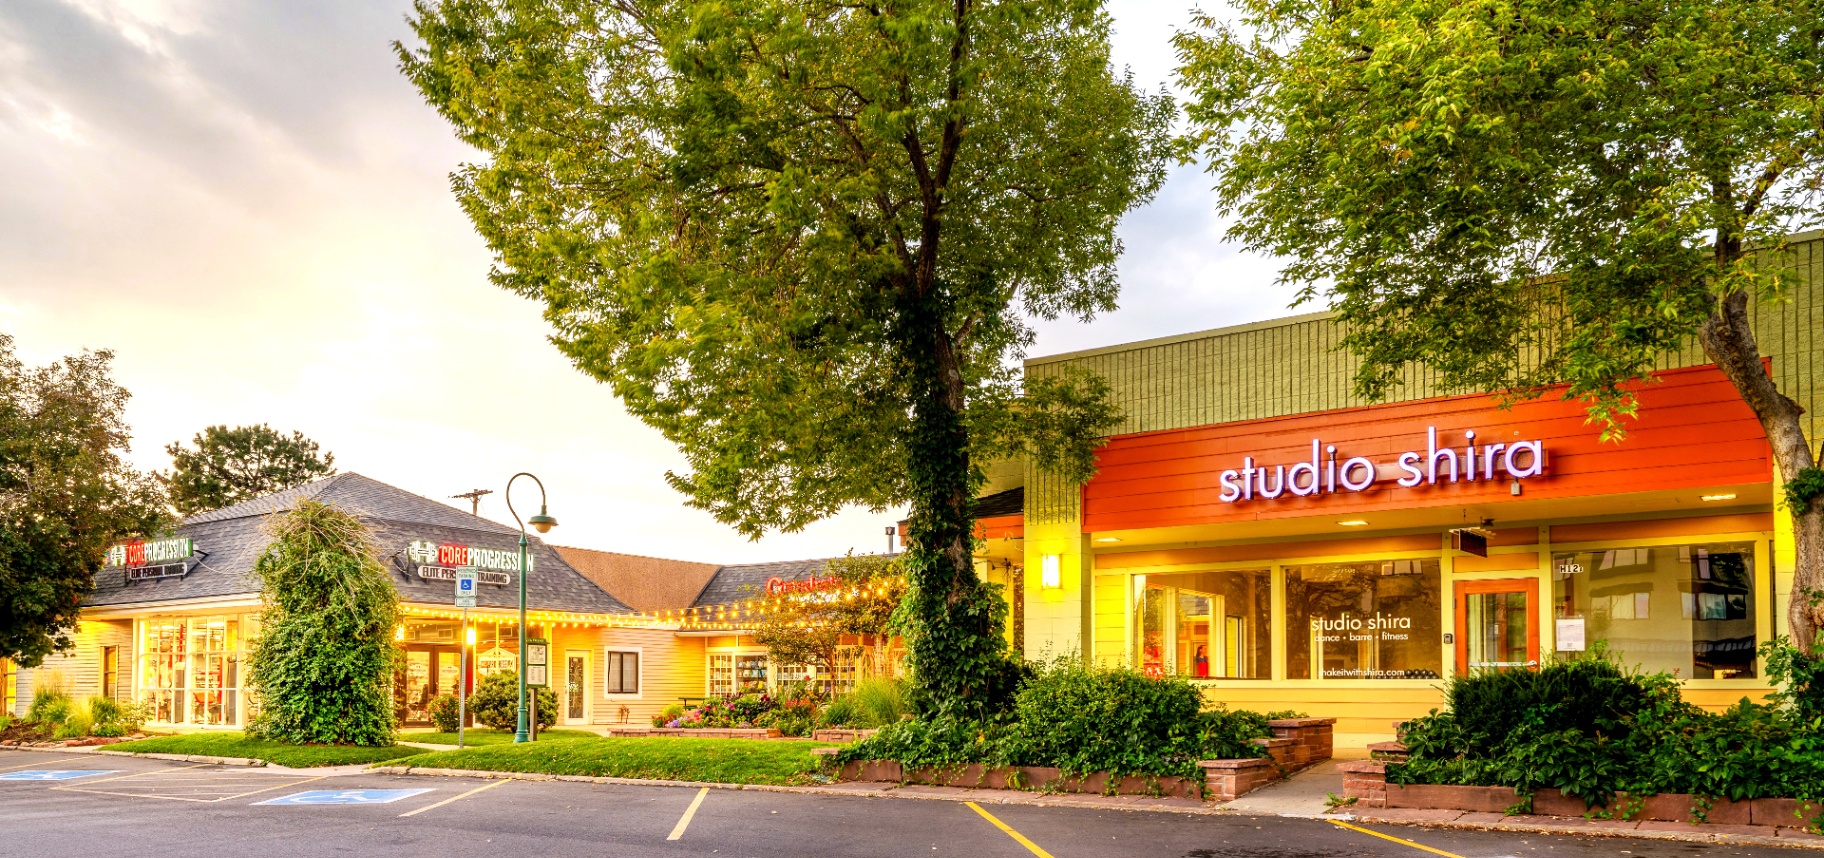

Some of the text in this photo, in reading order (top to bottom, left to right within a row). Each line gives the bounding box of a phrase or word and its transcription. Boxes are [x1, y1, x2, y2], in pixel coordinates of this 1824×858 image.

[1219, 426, 1545, 503] studio shira
[441, 545, 534, 572] COREPROGRESSIN
[422, 566, 507, 584] ELITE PERS TRAINING
[1311, 611, 1411, 631] studio shira
[1315, 631, 1409, 642] dance barre fitness
